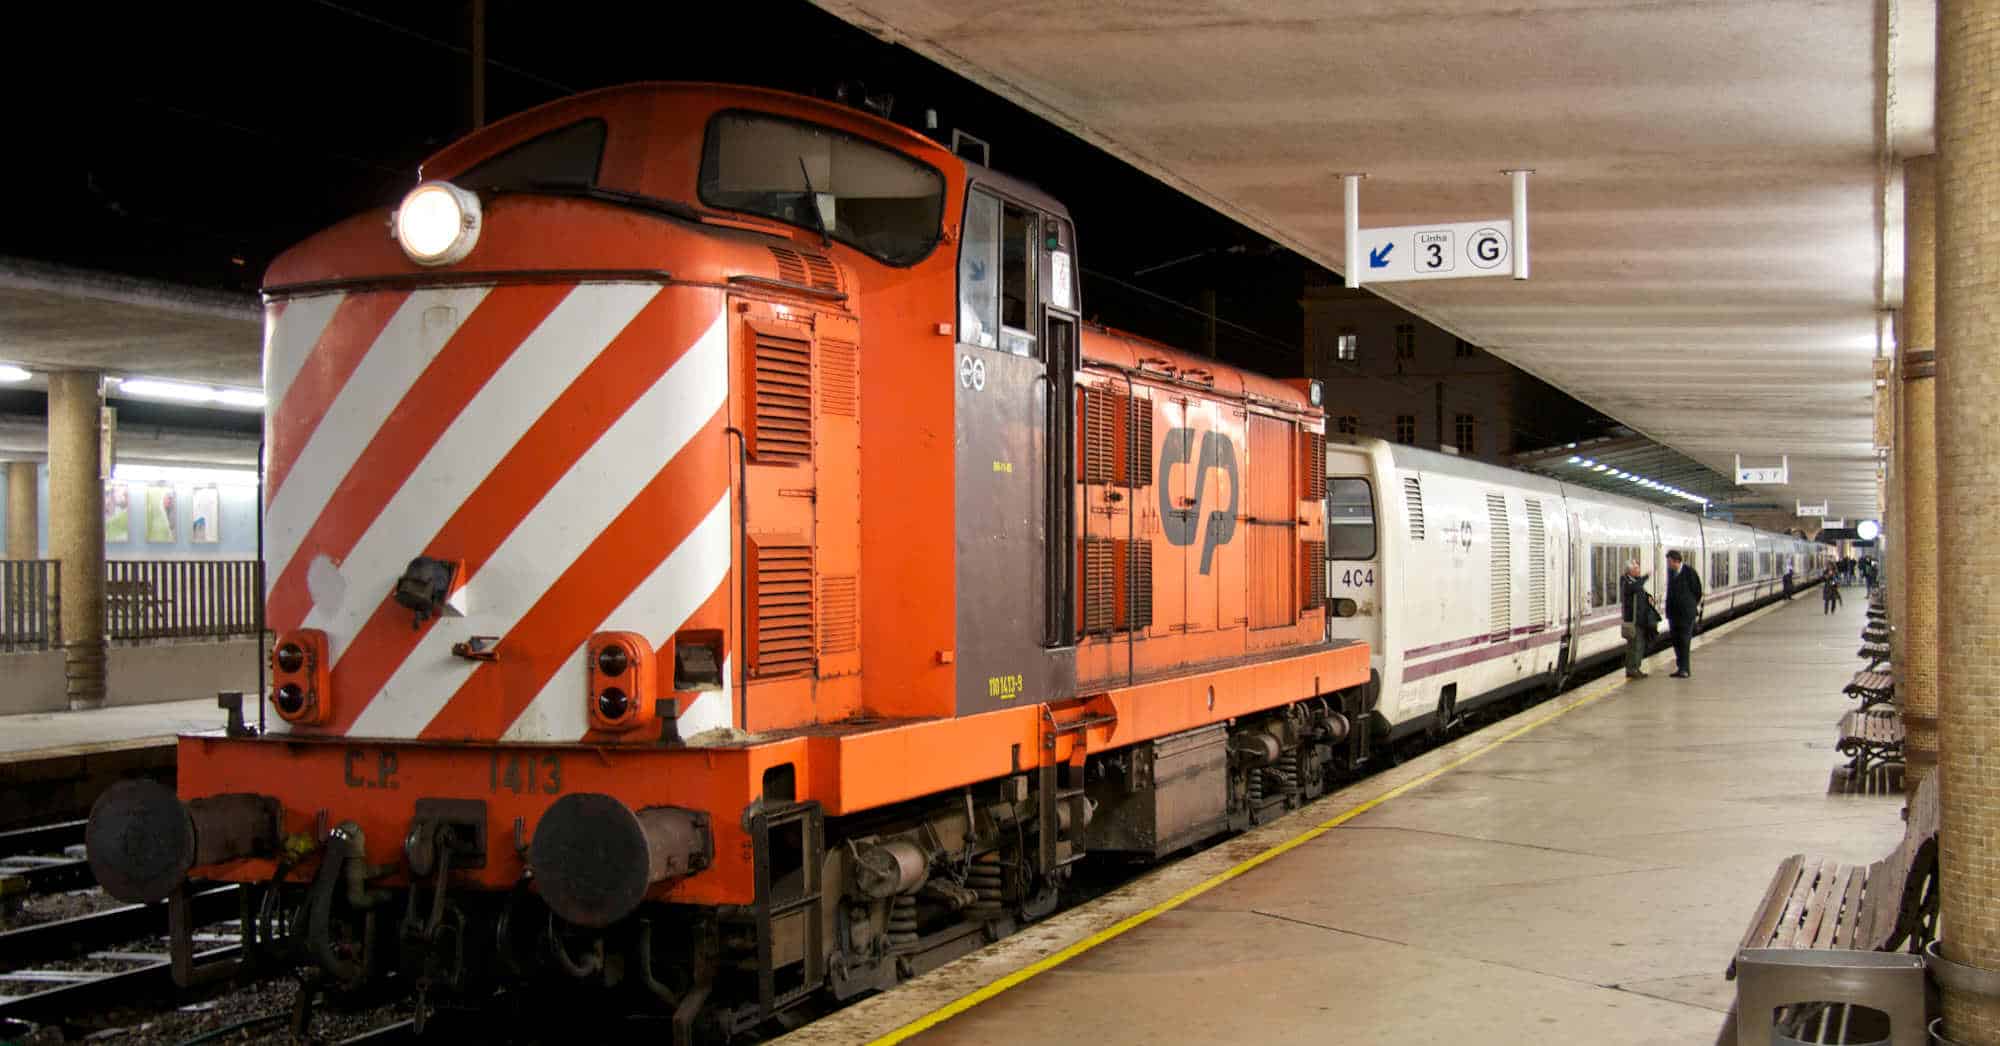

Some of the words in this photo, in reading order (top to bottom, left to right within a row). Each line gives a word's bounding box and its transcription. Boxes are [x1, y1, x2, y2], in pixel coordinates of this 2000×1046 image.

[1427, 244, 1442, 268] 3
[1477, 237, 1499, 261] G
[1342, 569, 1374, 588] 4C4
[490, 752, 561, 795] 1413
